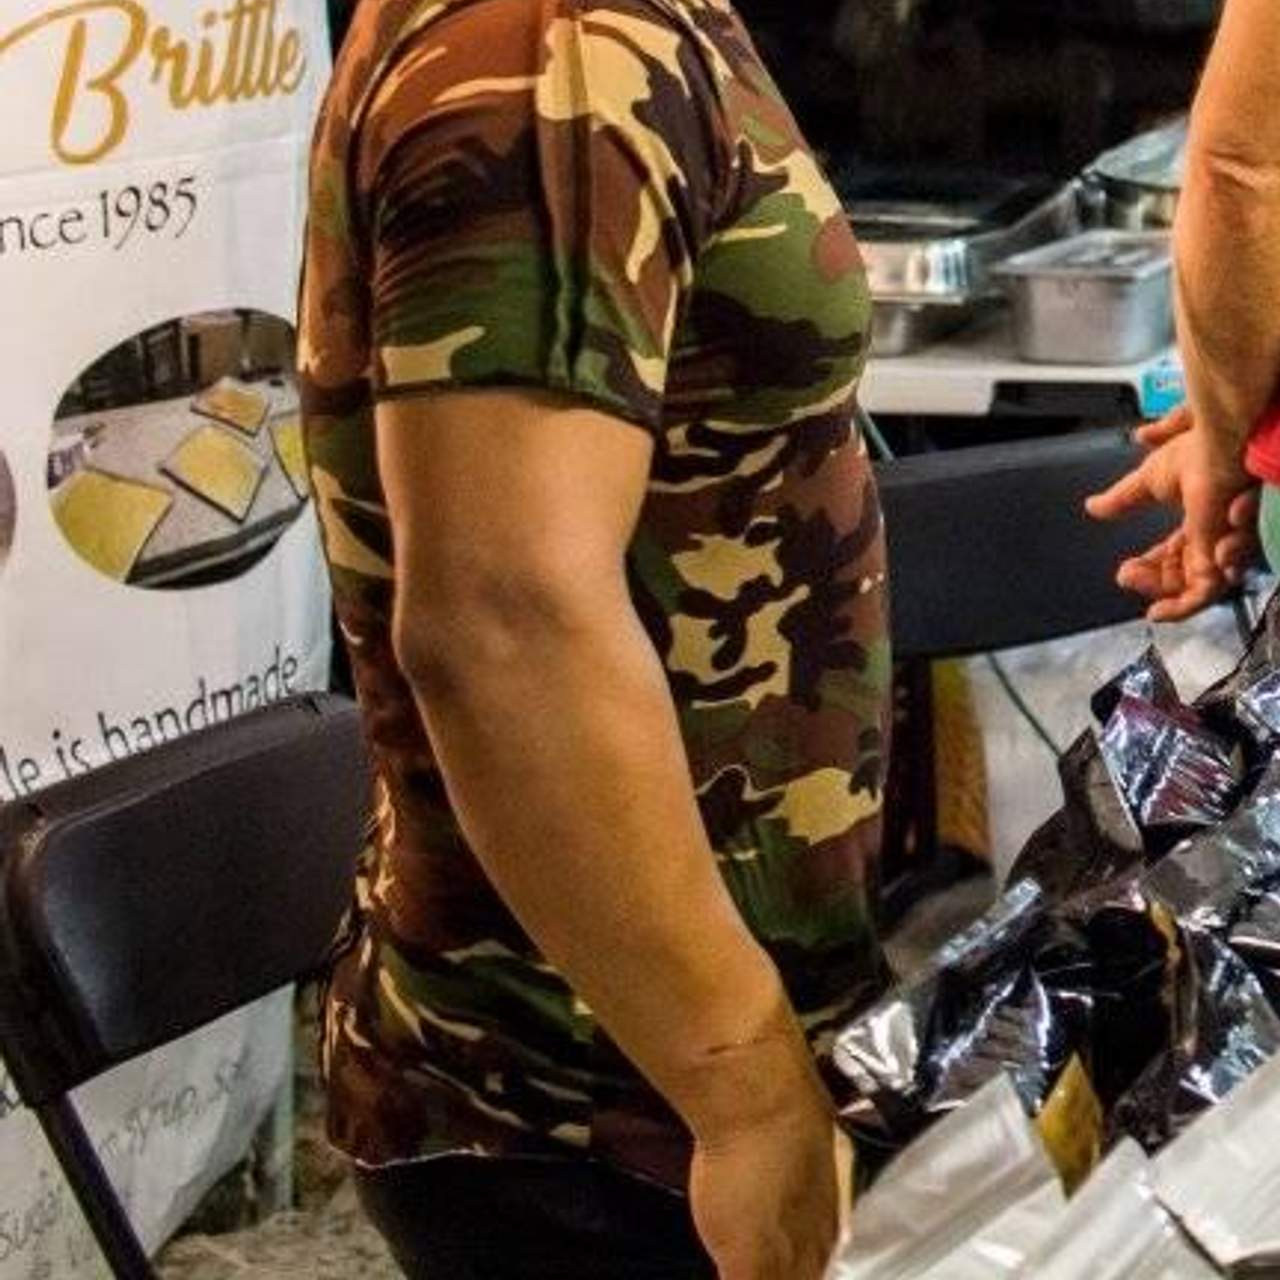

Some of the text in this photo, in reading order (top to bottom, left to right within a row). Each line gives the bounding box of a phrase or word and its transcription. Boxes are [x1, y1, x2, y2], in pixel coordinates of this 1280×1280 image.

[0, 175, 198, 254] nce 1985
[0, 645, 299, 798] le is handmade
